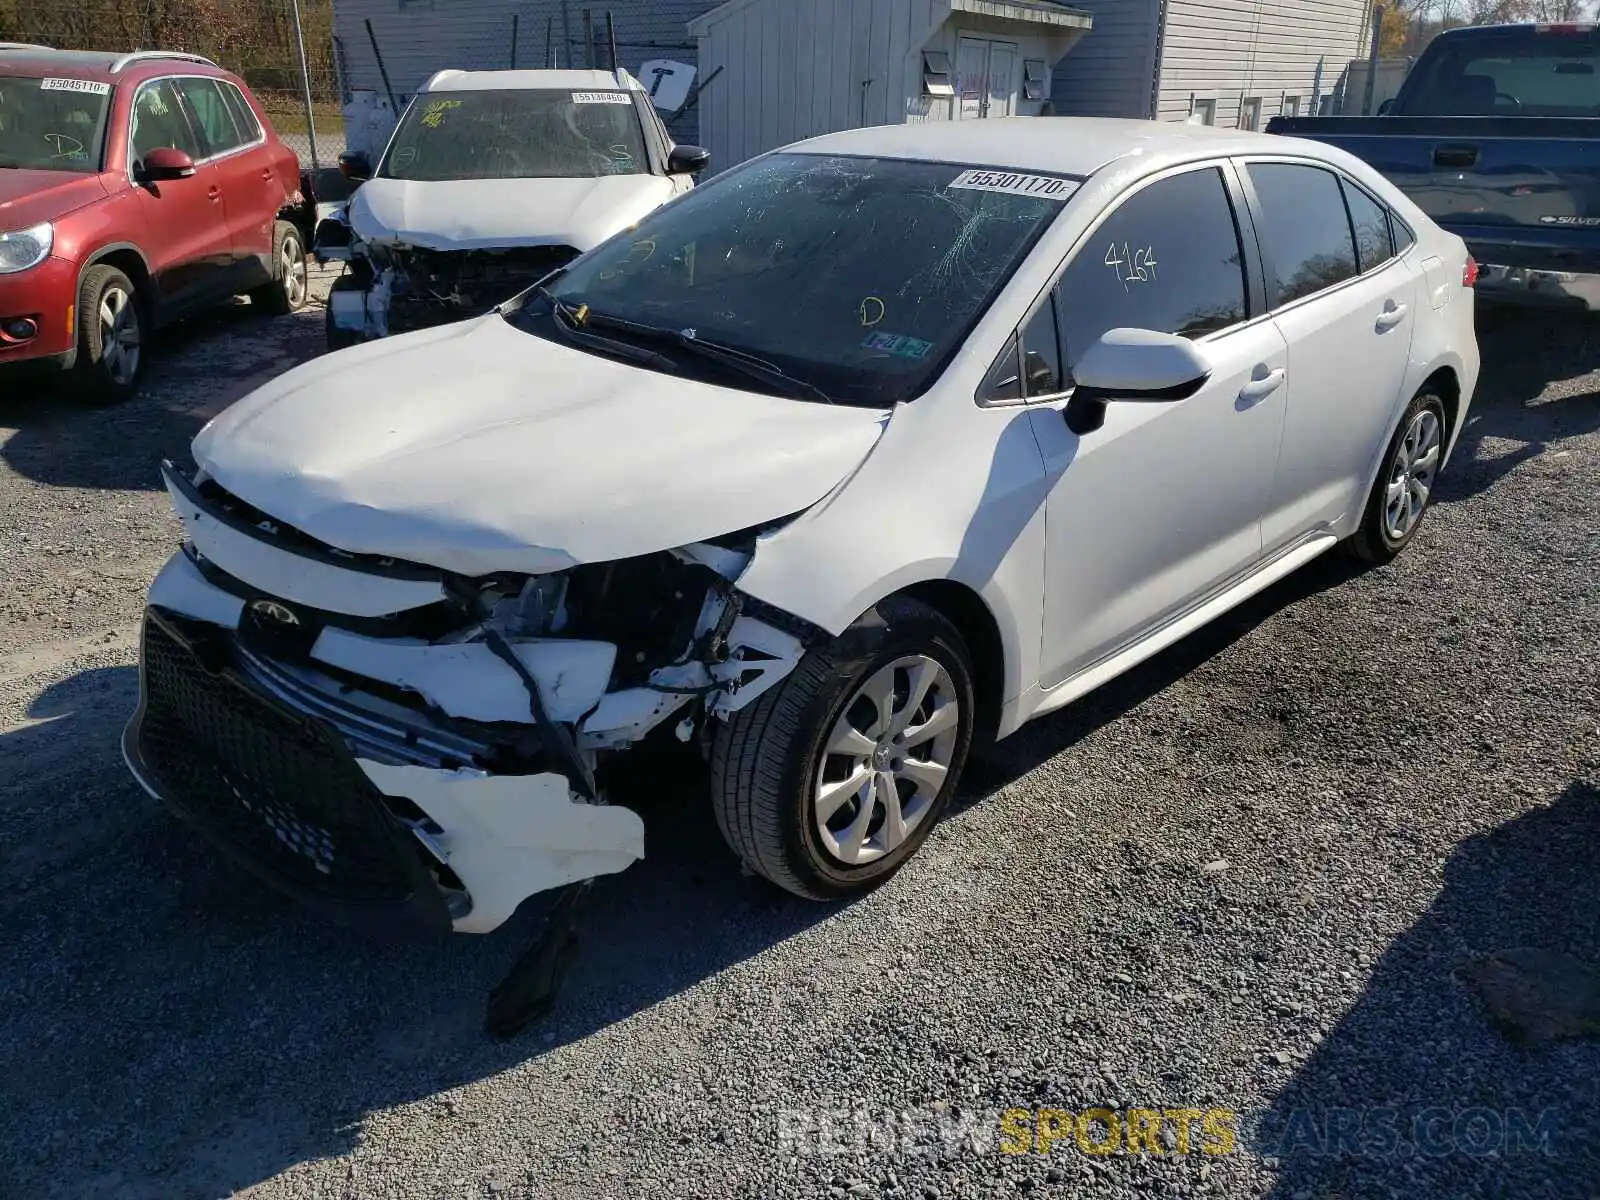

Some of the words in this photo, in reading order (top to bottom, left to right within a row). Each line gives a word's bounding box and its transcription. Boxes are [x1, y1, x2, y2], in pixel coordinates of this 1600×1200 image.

[649, 68, 675, 97] T
[1104, 241, 1158, 294] 4164
[860, 296, 885, 326] D
